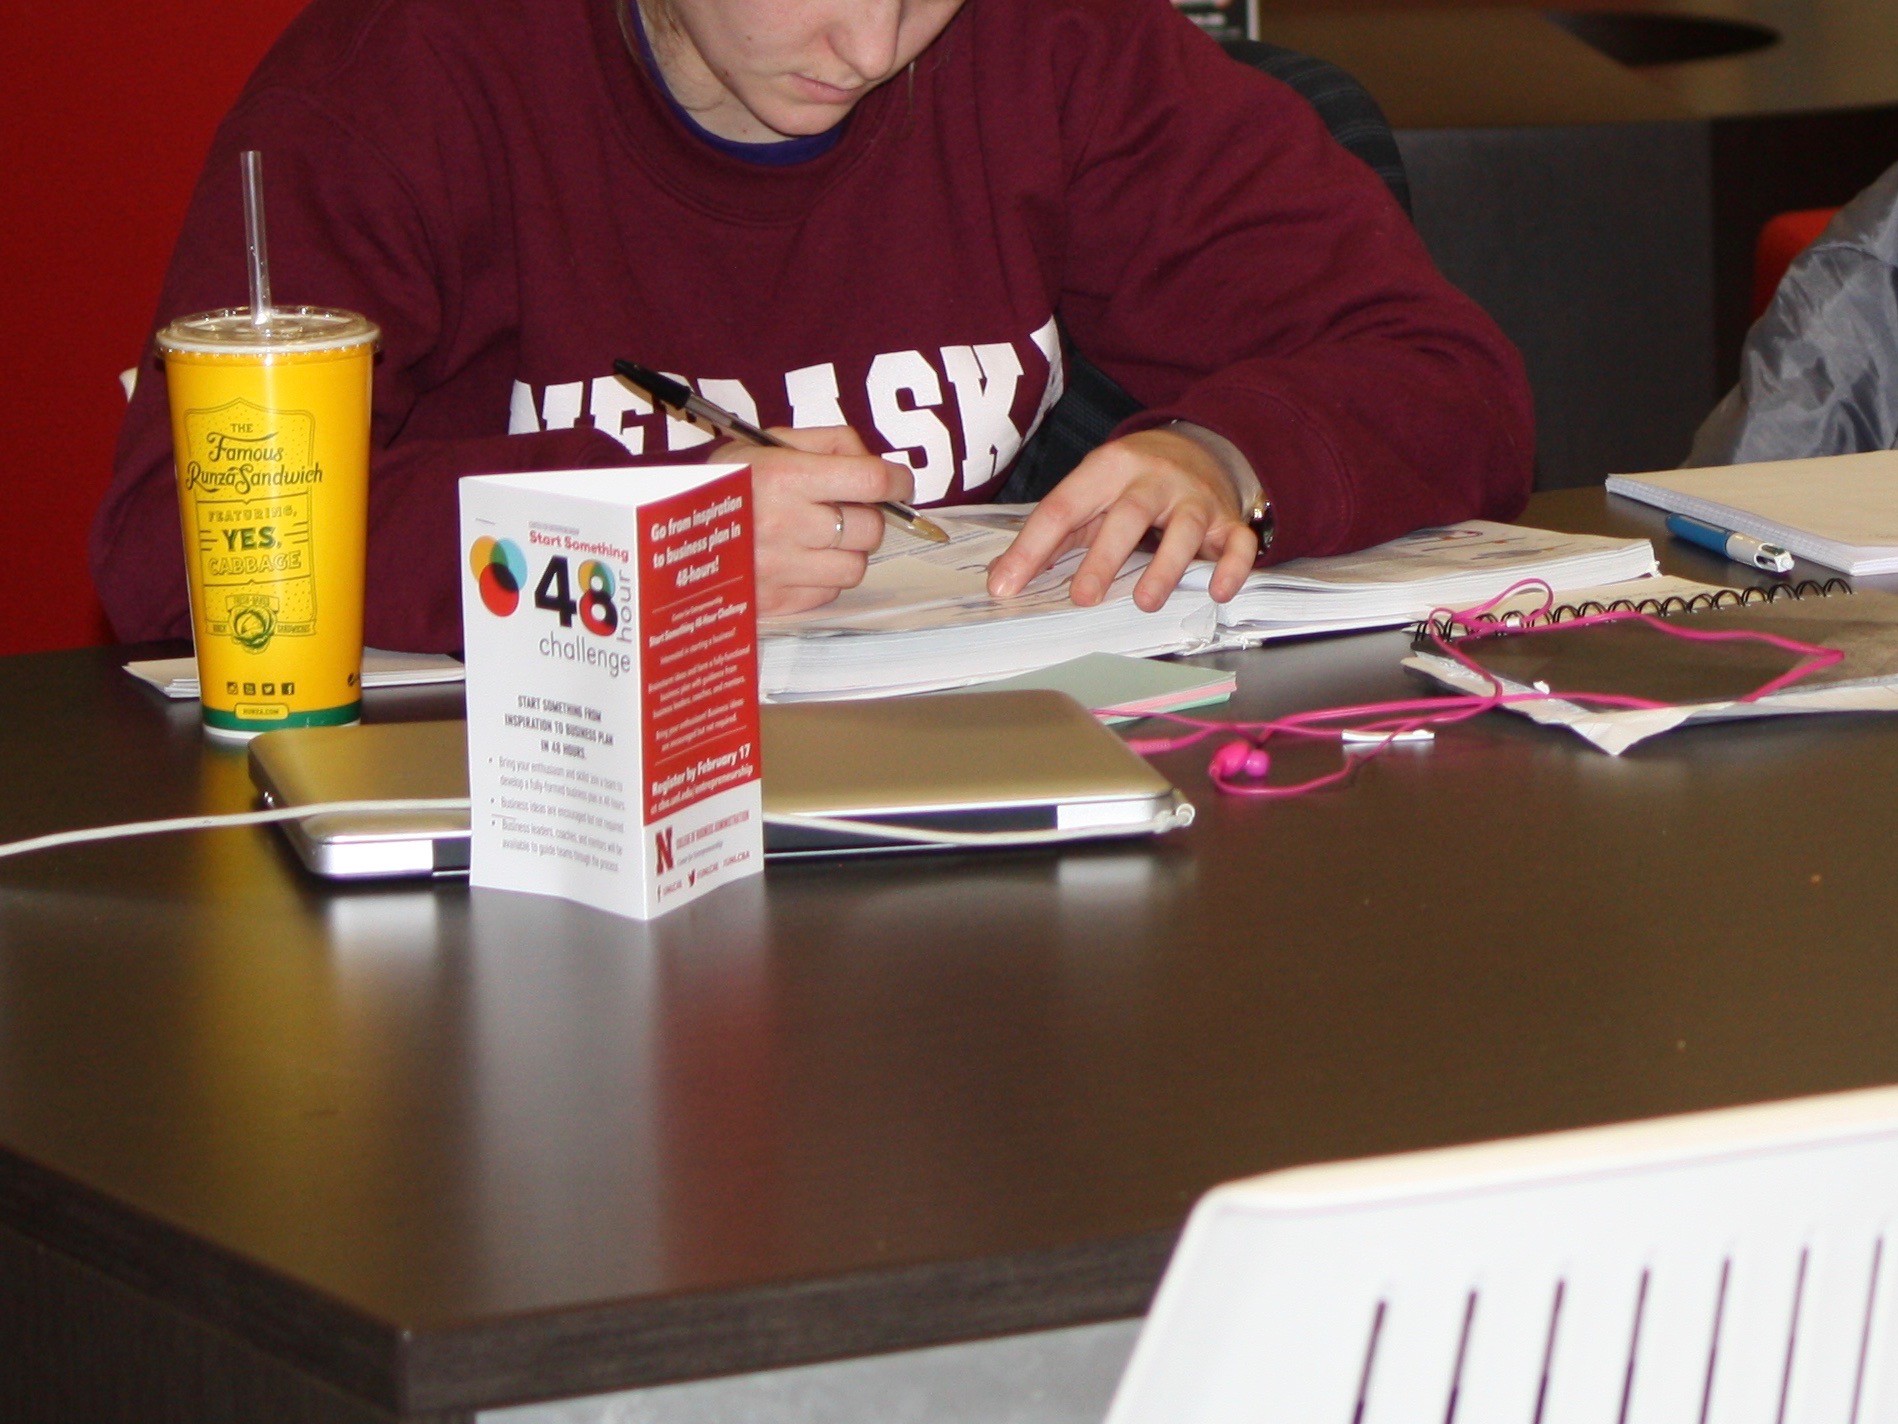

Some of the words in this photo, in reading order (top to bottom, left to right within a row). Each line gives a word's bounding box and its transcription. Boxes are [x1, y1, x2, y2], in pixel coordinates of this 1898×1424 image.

[230, 423, 253, 433] THE
[207, 431, 284, 462] Famous
[235, 462, 323, 495] Sandwich
[651, 523, 667, 542] Go
[668, 517, 691, 536] from
[692, 495, 742, 526] inspiration
[222, 526, 282, 552] YES,
[529, 530, 561, 547] Start
[564, 536, 630, 563] Something
[653, 553, 665, 569] to
[666, 540, 708, 565] business
[708, 527, 730, 552] plan
[731, 521, 741, 539] in
[209, 550, 302, 576] CABBAGE
[675, 554, 719, 587] 48-hours!
[534, 554, 618, 637] 48
[616, 569, 632, 643] hour
[539, 631, 631, 678] challenge
[517, 695, 541, 709] START
[542, 698, 583, 718] SOMETHING
[583, 707, 602, 722] FROM
[504, 713, 552, 733] INSPIRATION
[554, 720, 564, 735] TO
[565, 723, 596, 742] BUSINESS
[597, 733, 614, 745] PLAN
[540, 739, 549, 752] IN
[551, 741, 561, 754] 48
[652, 771, 686, 797] Register
[686, 766, 697, 783] by
[697, 750, 738, 775] February
[738, 742, 751, 759] 17
[655, 826, 674, 875] N
